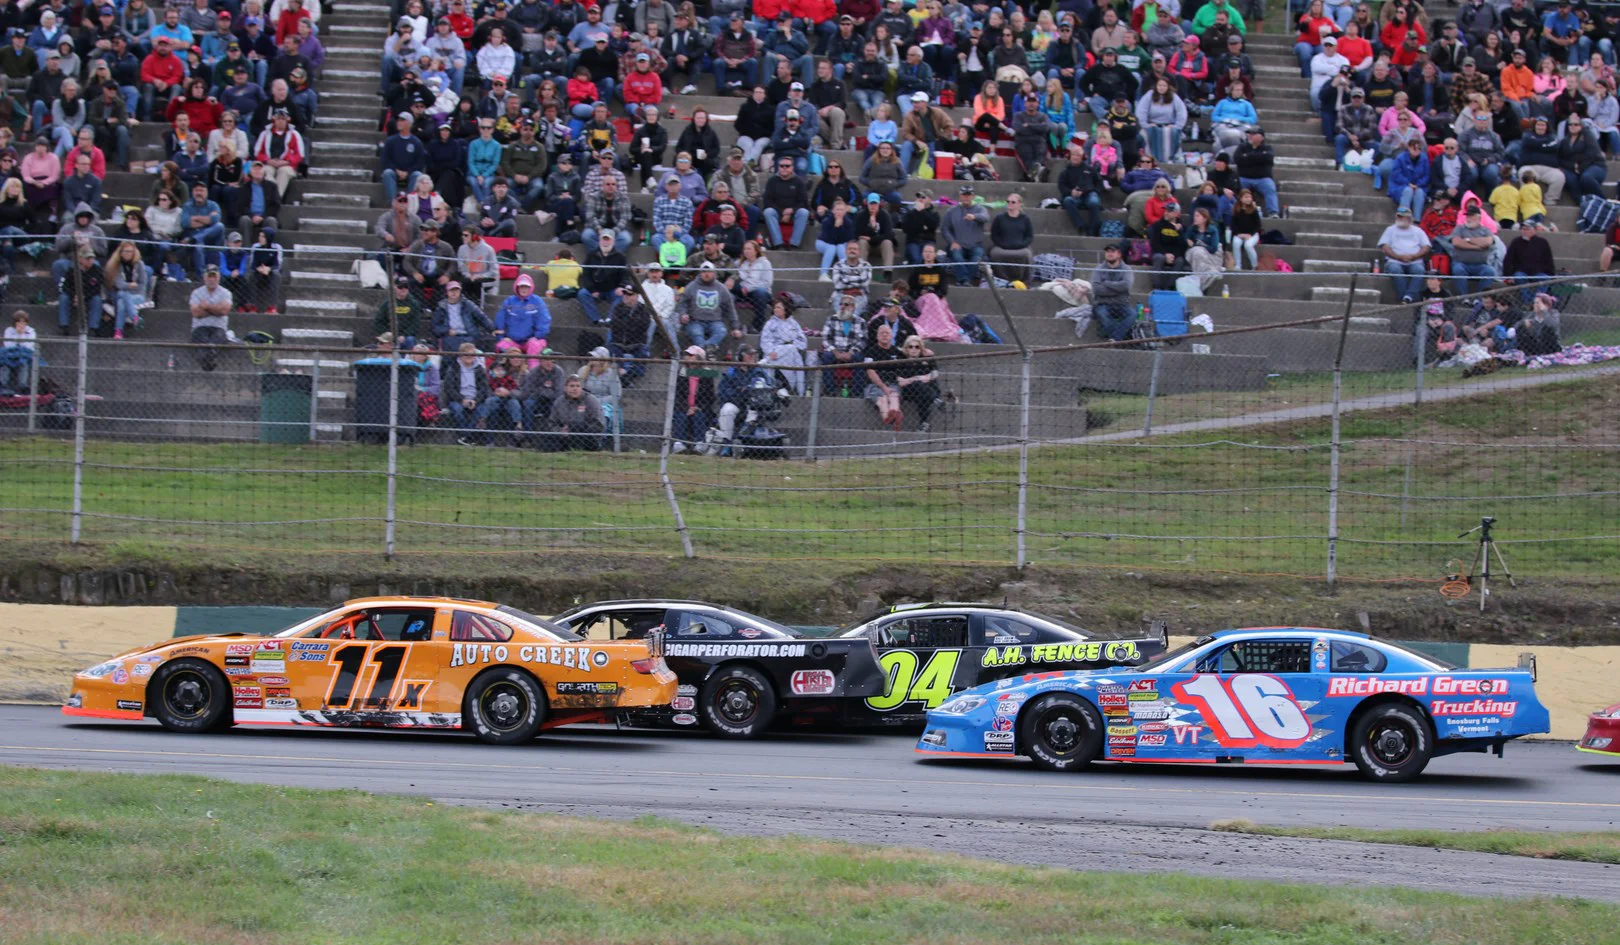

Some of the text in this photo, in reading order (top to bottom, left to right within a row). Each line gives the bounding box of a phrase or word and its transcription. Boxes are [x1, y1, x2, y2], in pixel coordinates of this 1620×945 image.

[229, 644, 253, 652] MSD
[256, 640, 283, 650] ACT
[291, 641, 329, 651] Carrara
[169, 646, 210, 657] AMERICAN
[300, 652, 326, 661] Sons
[981, 646, 1026, 667] A.H.
[1032, 642, 1101, 663] FENCE
[450, 643, 591, 672] AUTO CREEK
[864, 649, 962, 711] 04
[1128, 679, 1157, 691] ACT
[1036, 681, 1079, 691] AMERICAN
[1328, 676, 1428, 697] Richard
[234, 687, 260, 697] Holley
[1099, 695, 1126, 705] Holley
[1176, 674, 1311, 744] 16
[1431, 699, 1518, 717] Trucking
[1110, 726, 1135, 734] Bassett
[1172, 725, 1203, 745] VT
